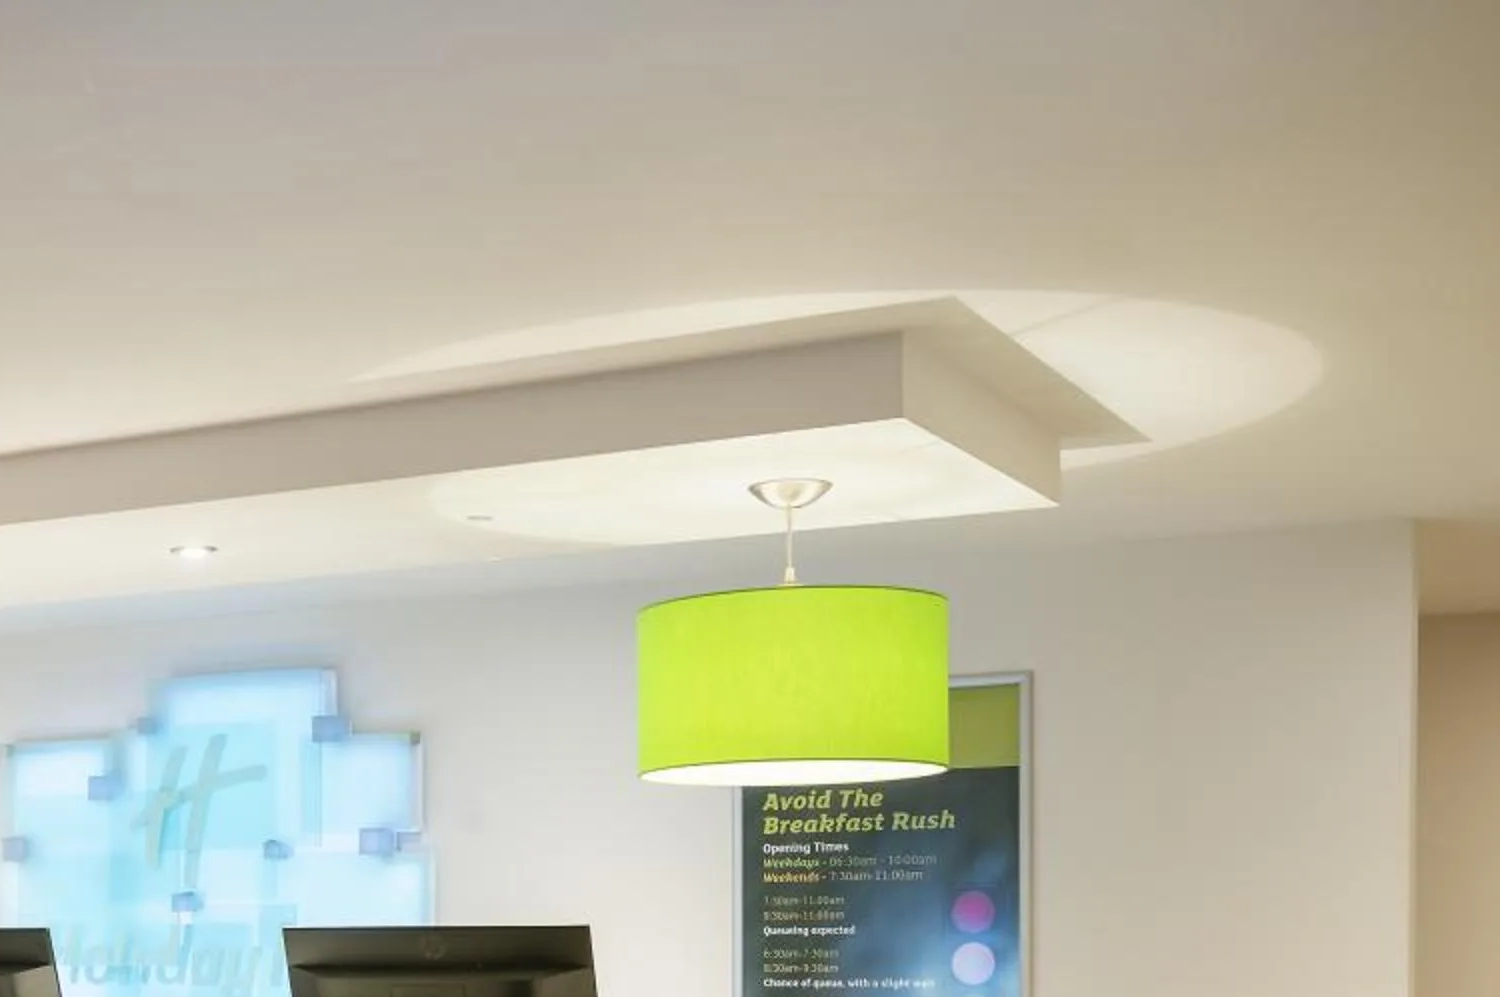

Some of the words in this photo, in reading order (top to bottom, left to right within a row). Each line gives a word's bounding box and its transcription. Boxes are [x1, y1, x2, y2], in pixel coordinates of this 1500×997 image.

[762, 789, 832, 811] Avoid
[838, 788, 884, 808] The
[763, 812, 885, 834] Breakfast
[891, 809, 956, 831] Rush
[763, 843, 811, 855] Opening
[813, 841, 850, 852] Times
[763, 856, 820, 869] Weekdays
[763, 870, 820, 883] Weekends
[763, 925, 809, 937] Queueing
[811, 924, 857, 937] expected
[763, 977, 799, 988] Chance
[847, 977, 870, 988] with
